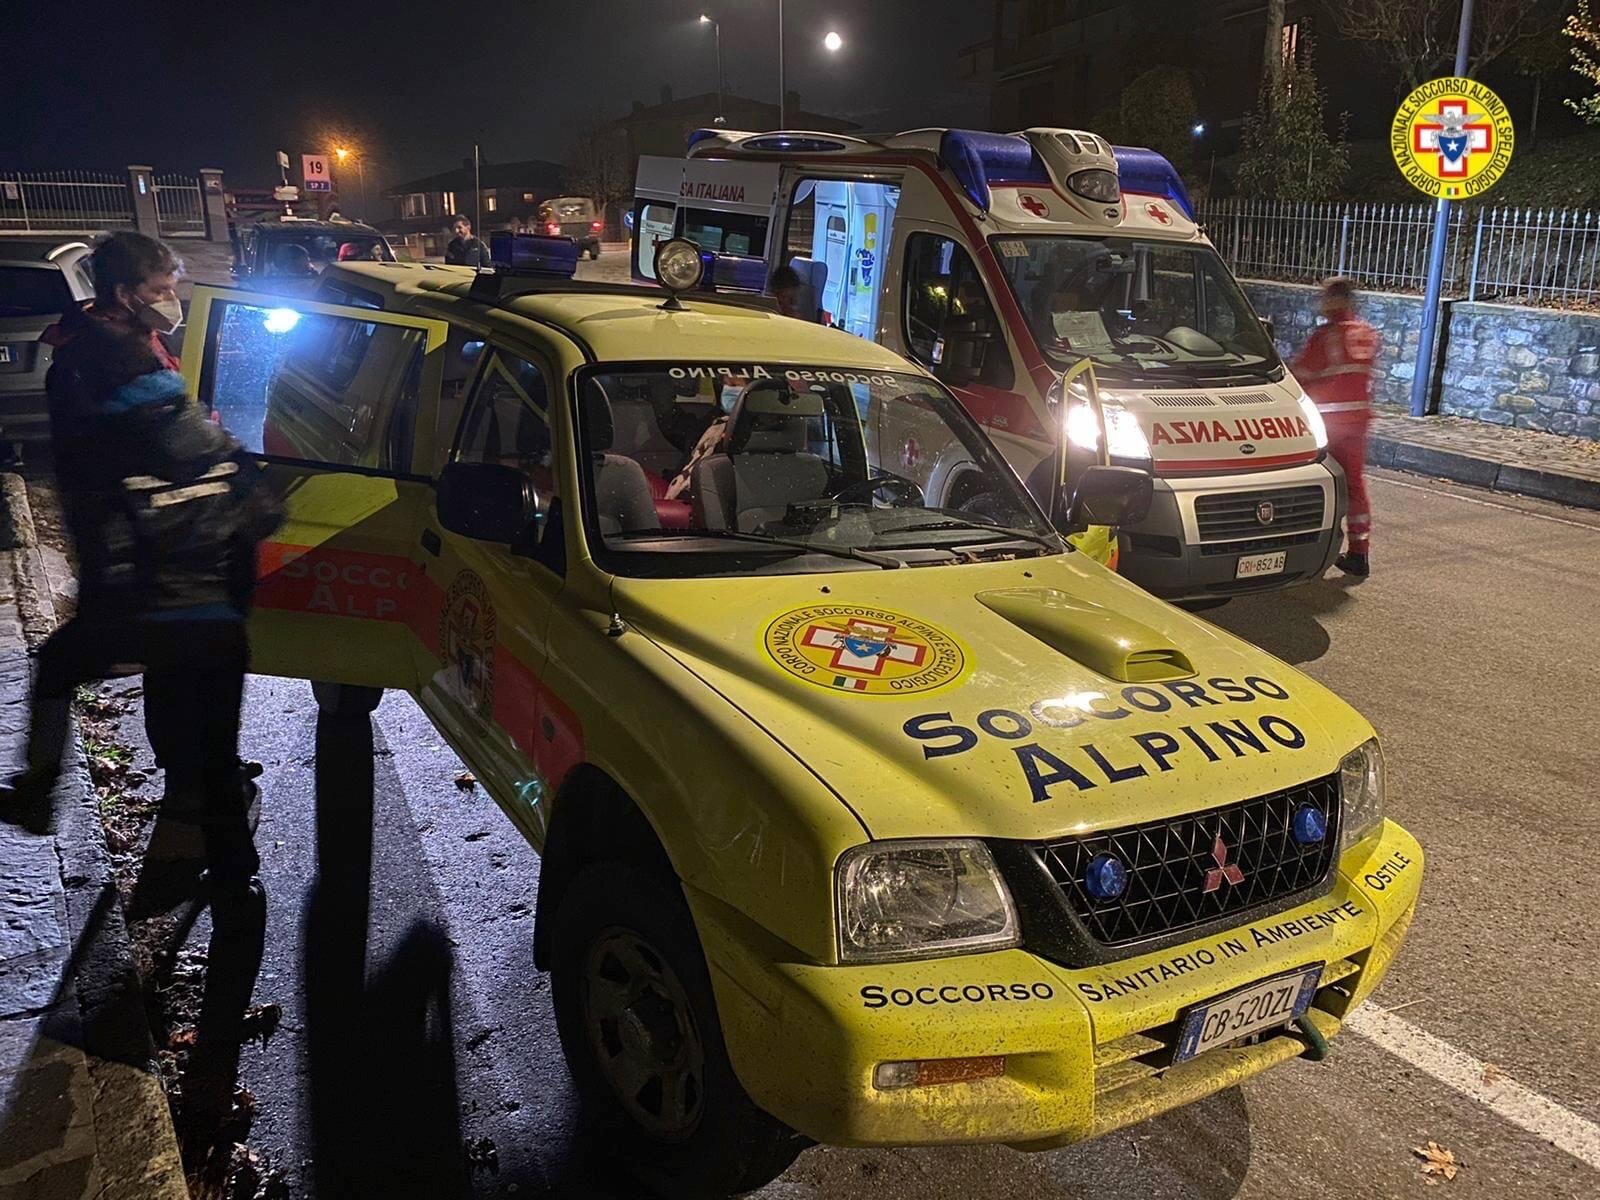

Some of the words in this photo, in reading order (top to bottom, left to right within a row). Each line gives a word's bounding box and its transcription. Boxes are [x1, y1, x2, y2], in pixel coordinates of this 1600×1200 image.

[309, 161, 323, 174] 19
[696, 183, 745, 202] ITALIANA
[773, 610, 815, 646] NAZIONALE
[813, 607, 896, 621] SOCCORSO
[896, 619, 944, 642] ALPINO
[776, 647, 816, 674] CORPO
[889, 648, 956, 690] SPELEOLOGICO
[902, 675, 1290, 761] SOCCORSO
[1012, 714, 1306, 803] ALPINO
[860, 982, 1054, 1009] SOCCORSO
[1078, 949, 1215, 1002] SANITARIO
[1216, 938, 1248, 958] IN
[1249, 900, 1364, 948] AMBIENTE
[1364, 851, 1411, 891] OSTILE
